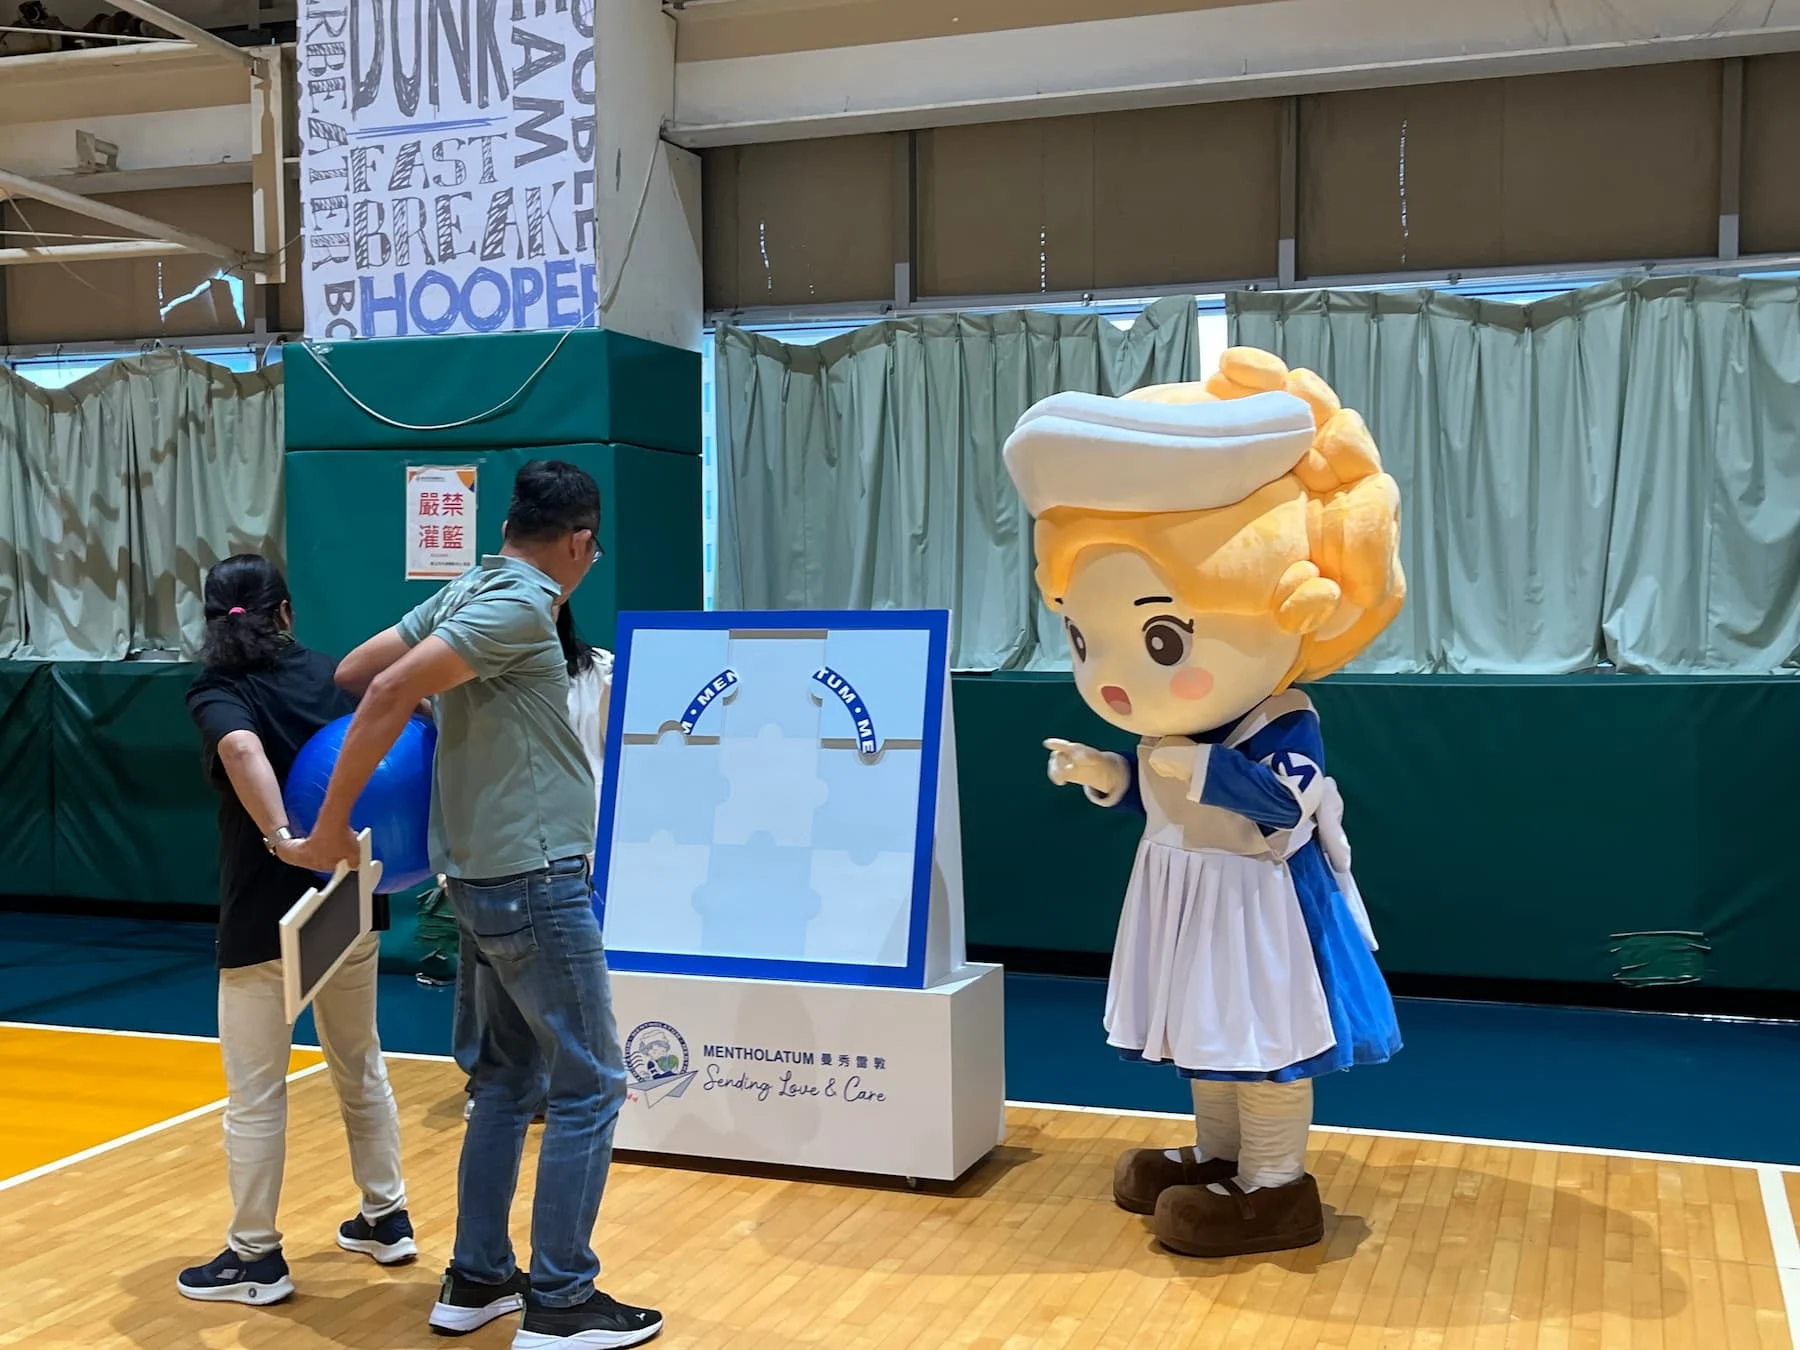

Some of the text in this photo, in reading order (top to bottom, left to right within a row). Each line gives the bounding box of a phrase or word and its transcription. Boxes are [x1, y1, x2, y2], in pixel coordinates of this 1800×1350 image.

[350, 0, 509, 118] DUNK
[305, 0, 350, 271] RBEATER
[350, 133, 508, 194] FAST
[353, 180, 570, 270] BREAK
[418, 492, 464, 517] 嚴禁
[418, 525, 464, 549] 灌籃
[703, 1045, 815, 1065] MENTHOLATUM
[703, 1063, 886, 1102] Sending Love & Care
